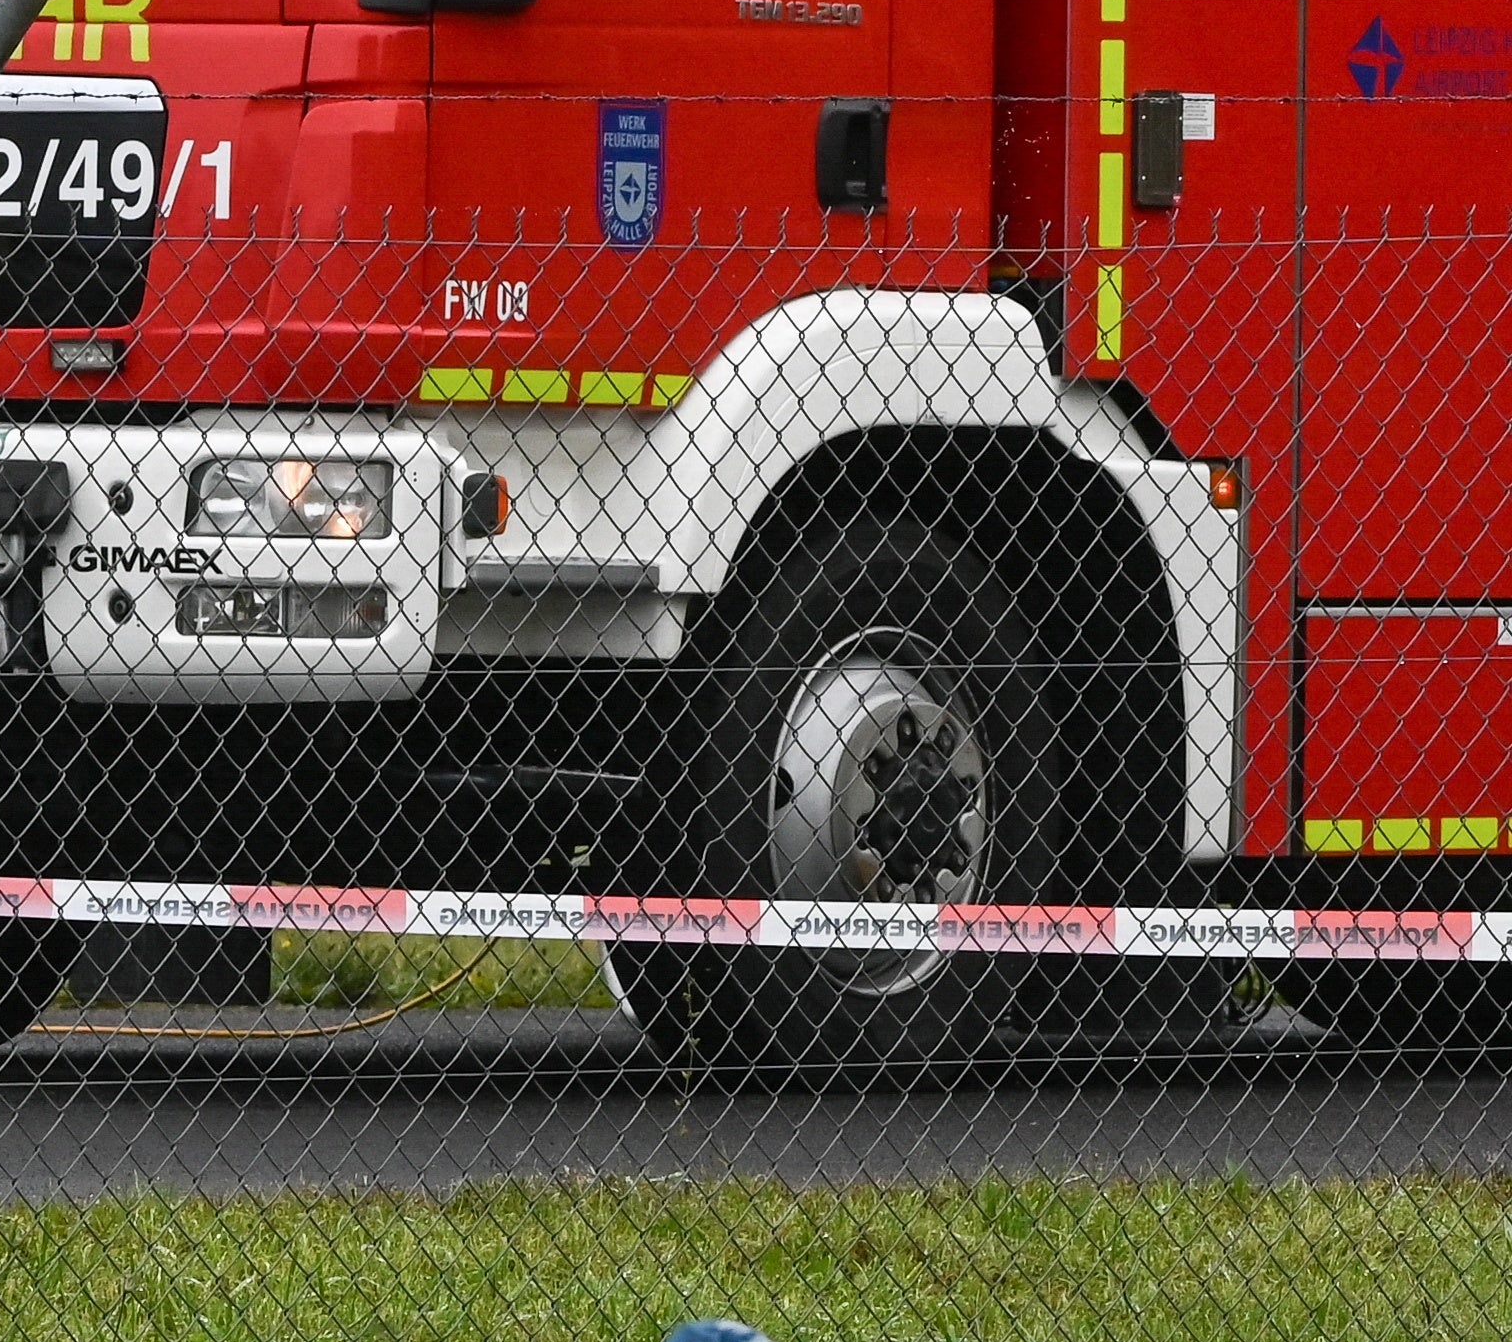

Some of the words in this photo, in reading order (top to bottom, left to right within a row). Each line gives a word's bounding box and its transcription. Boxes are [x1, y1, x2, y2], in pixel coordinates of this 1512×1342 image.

[785, 0, 863, 26] 13.290
[617, 114, 647, 131] WERK
[603, 132, 660, 149] FEUERWEHR
[445, 279, 489, 321] FW
[69, 544, 224, 575] GIMAEX
